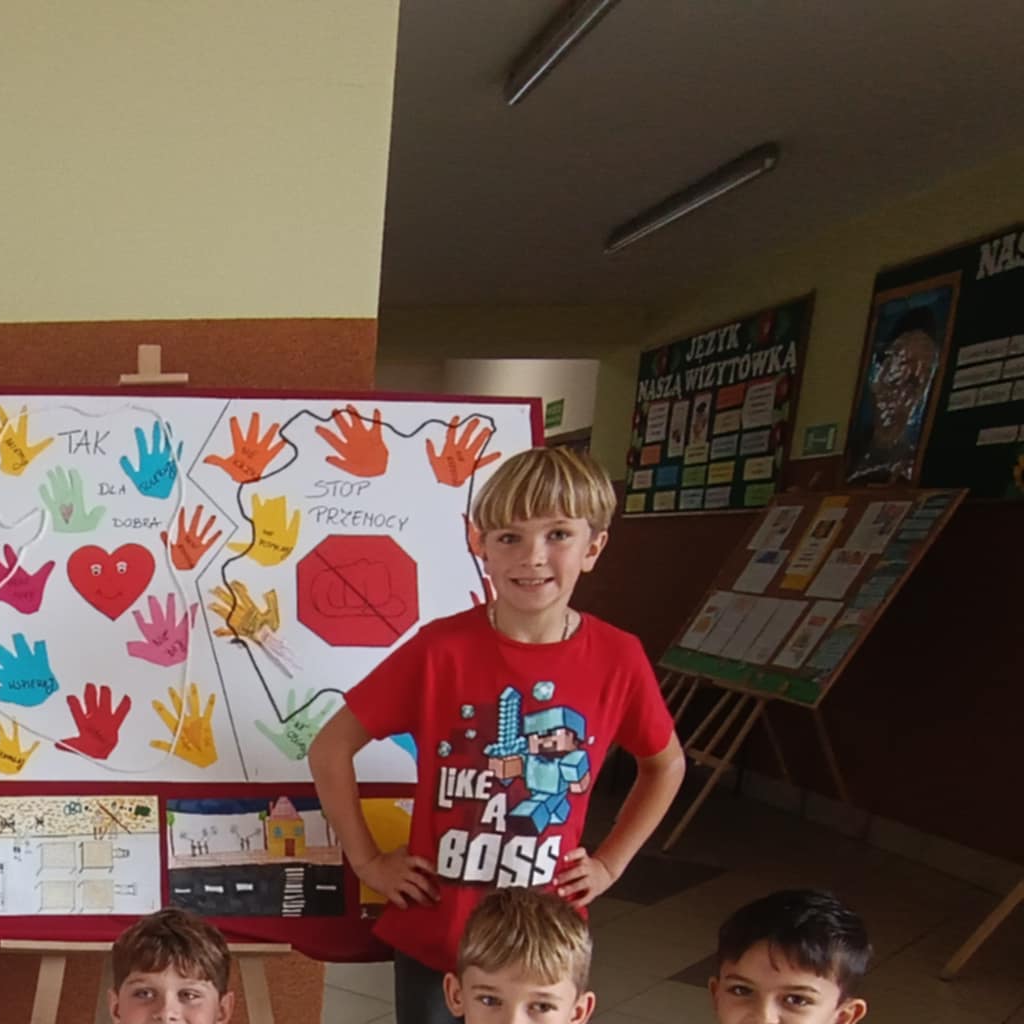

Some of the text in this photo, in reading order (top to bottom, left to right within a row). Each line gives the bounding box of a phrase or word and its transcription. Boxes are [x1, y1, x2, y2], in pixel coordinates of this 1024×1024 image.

[686, 323, 741, 364] JĘZYK
[58, 429, 111, 456] TAK
[98, 482, 127, 496] DLA
[305, 480, 372, 498] STOP
[112, 517, 163, 530] DOBRA
[481, 792, 507, 833] A
[437, 828, 563, 889] BOSS
